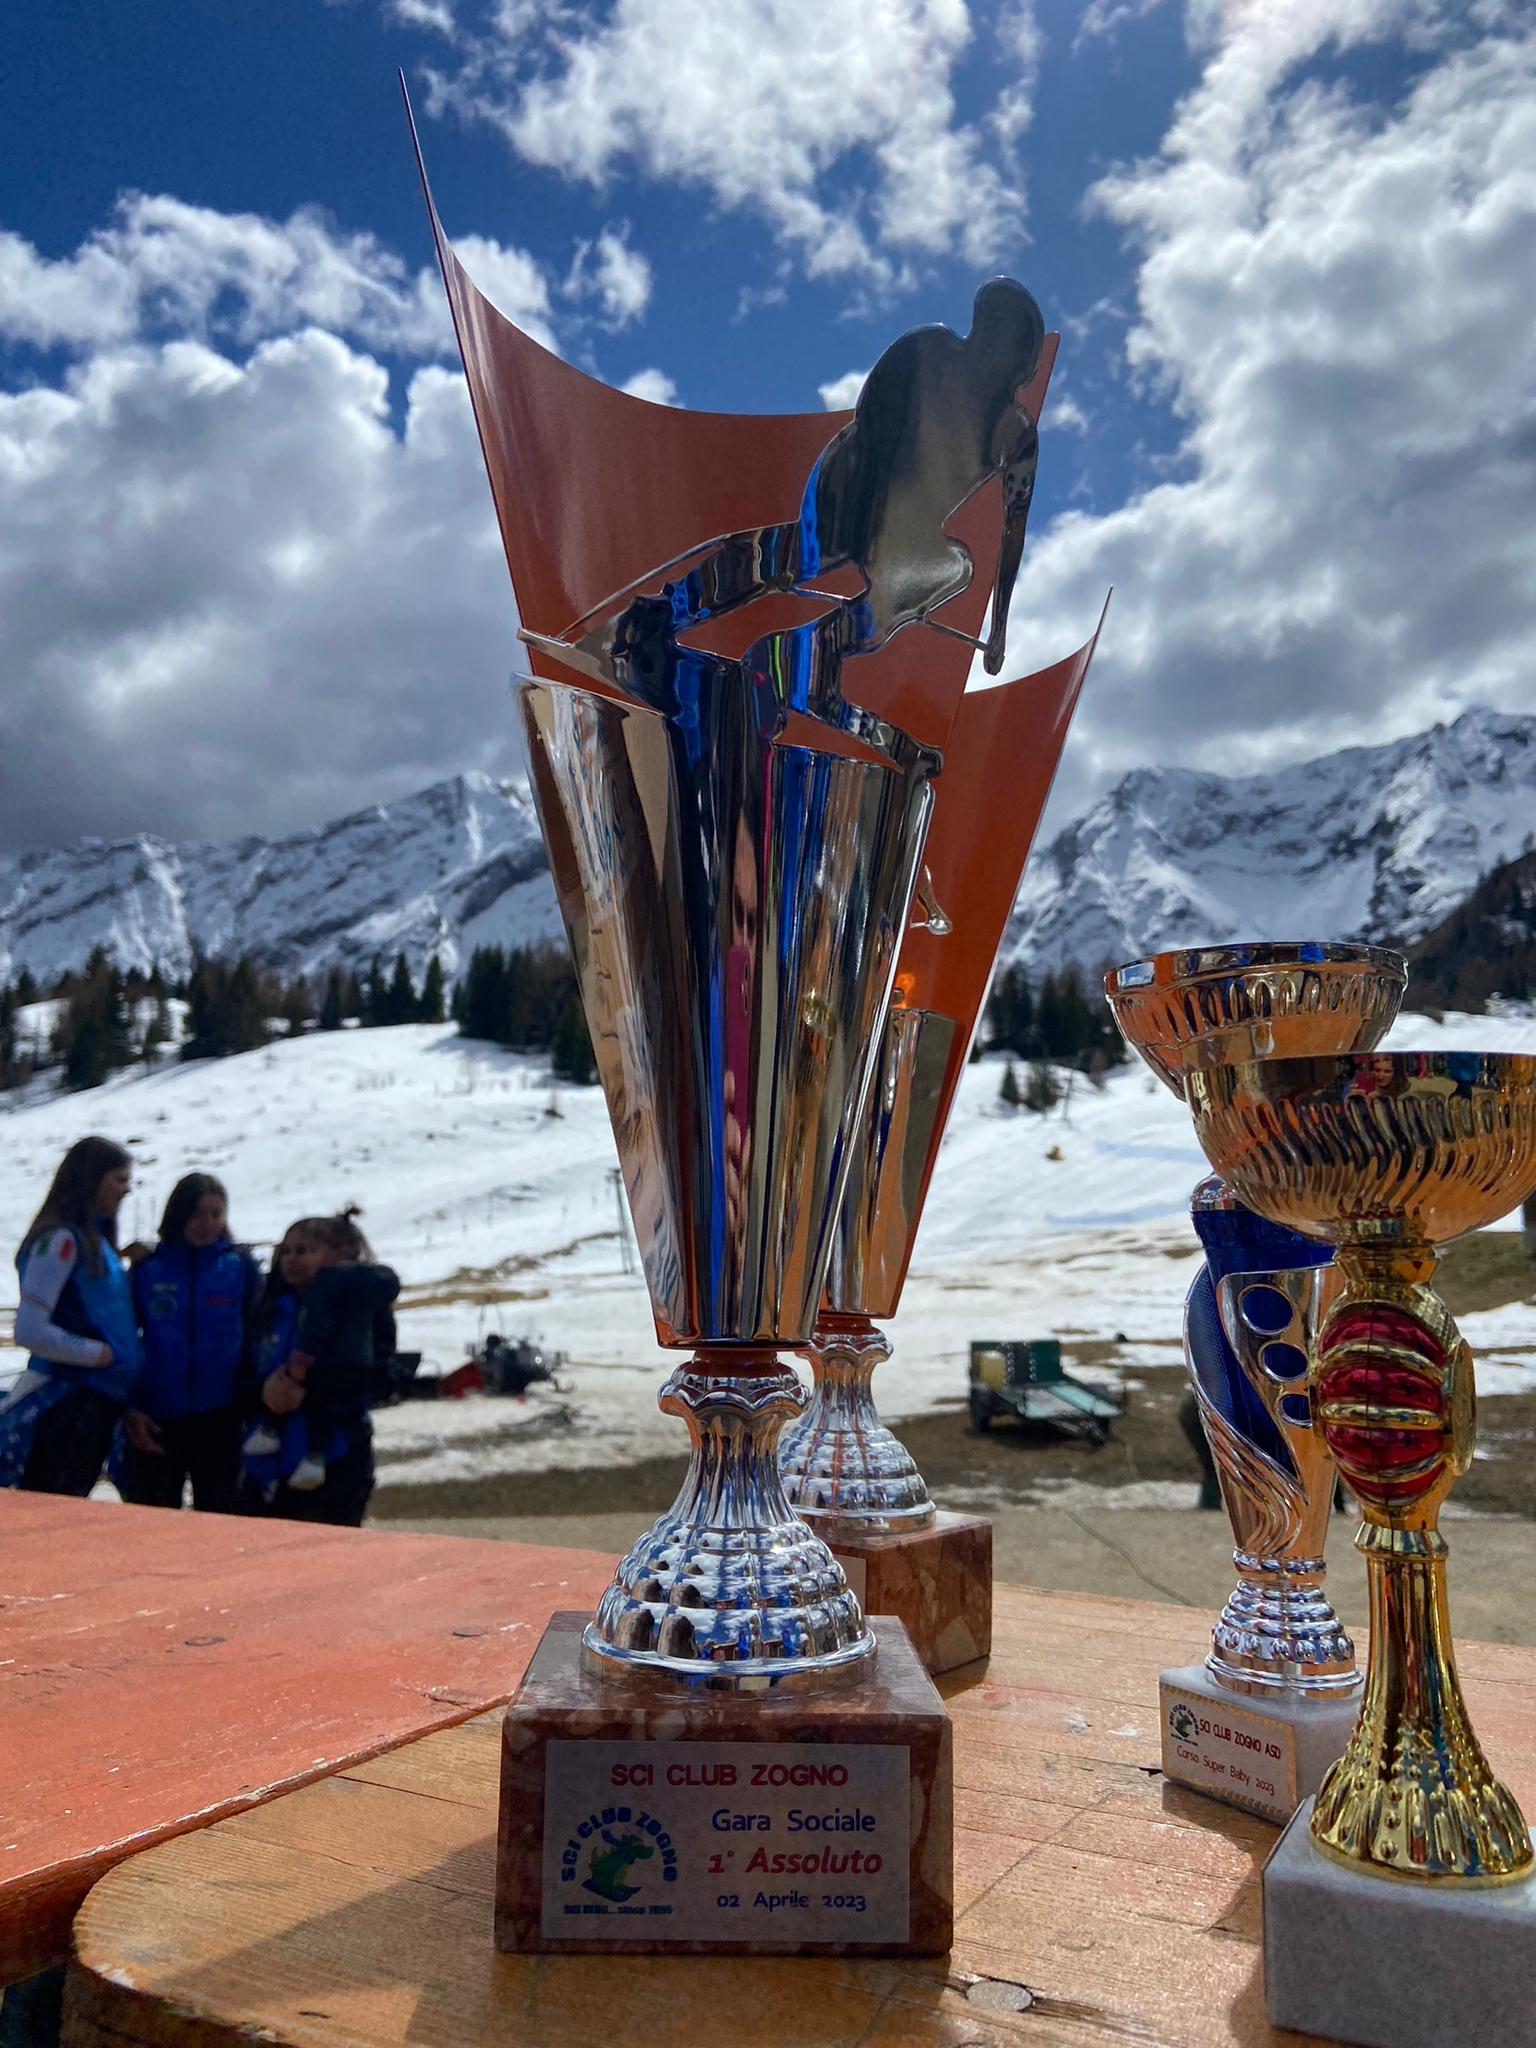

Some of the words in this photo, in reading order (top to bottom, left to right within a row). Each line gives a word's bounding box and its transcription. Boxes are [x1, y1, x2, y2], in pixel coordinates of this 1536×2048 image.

[1199, 1718, 1210, 1734] SCI
[1213, 1723, 1231, 1741] CLUB
[1234, 1731, 1262, 1752] ZOGNO
[1265, 1743, 1282, 1760] ASD
[610, 1764, 654, 1786] SCI
[666, 1764, 737, 1786] CLUB
[750, 1764, 849, 1787] ZOGNO
[1176, 1745, 1199, 1763] Corso
[1202, 1754, 1225, 1774] Super
[1230, 1765, 1251, 1786] Baby
[1255, 1778, 1275, 1796] 2023
[711, 1809, 772, 1832] Gara
[786, 1808, 876, 1833] Sociale
[561, 1839, 582, 1882] SCI
[577, 1806, 632, 1839] CLUB
[635, 1810, 678, 1882] ZOGNO
[745, 1845, 882, 1875] Assoluto
[716, 1894, 740, 1908] 02
[753, 1890, 810, 1912] Aprile
[822, 1895, 867, 1912] 2023
